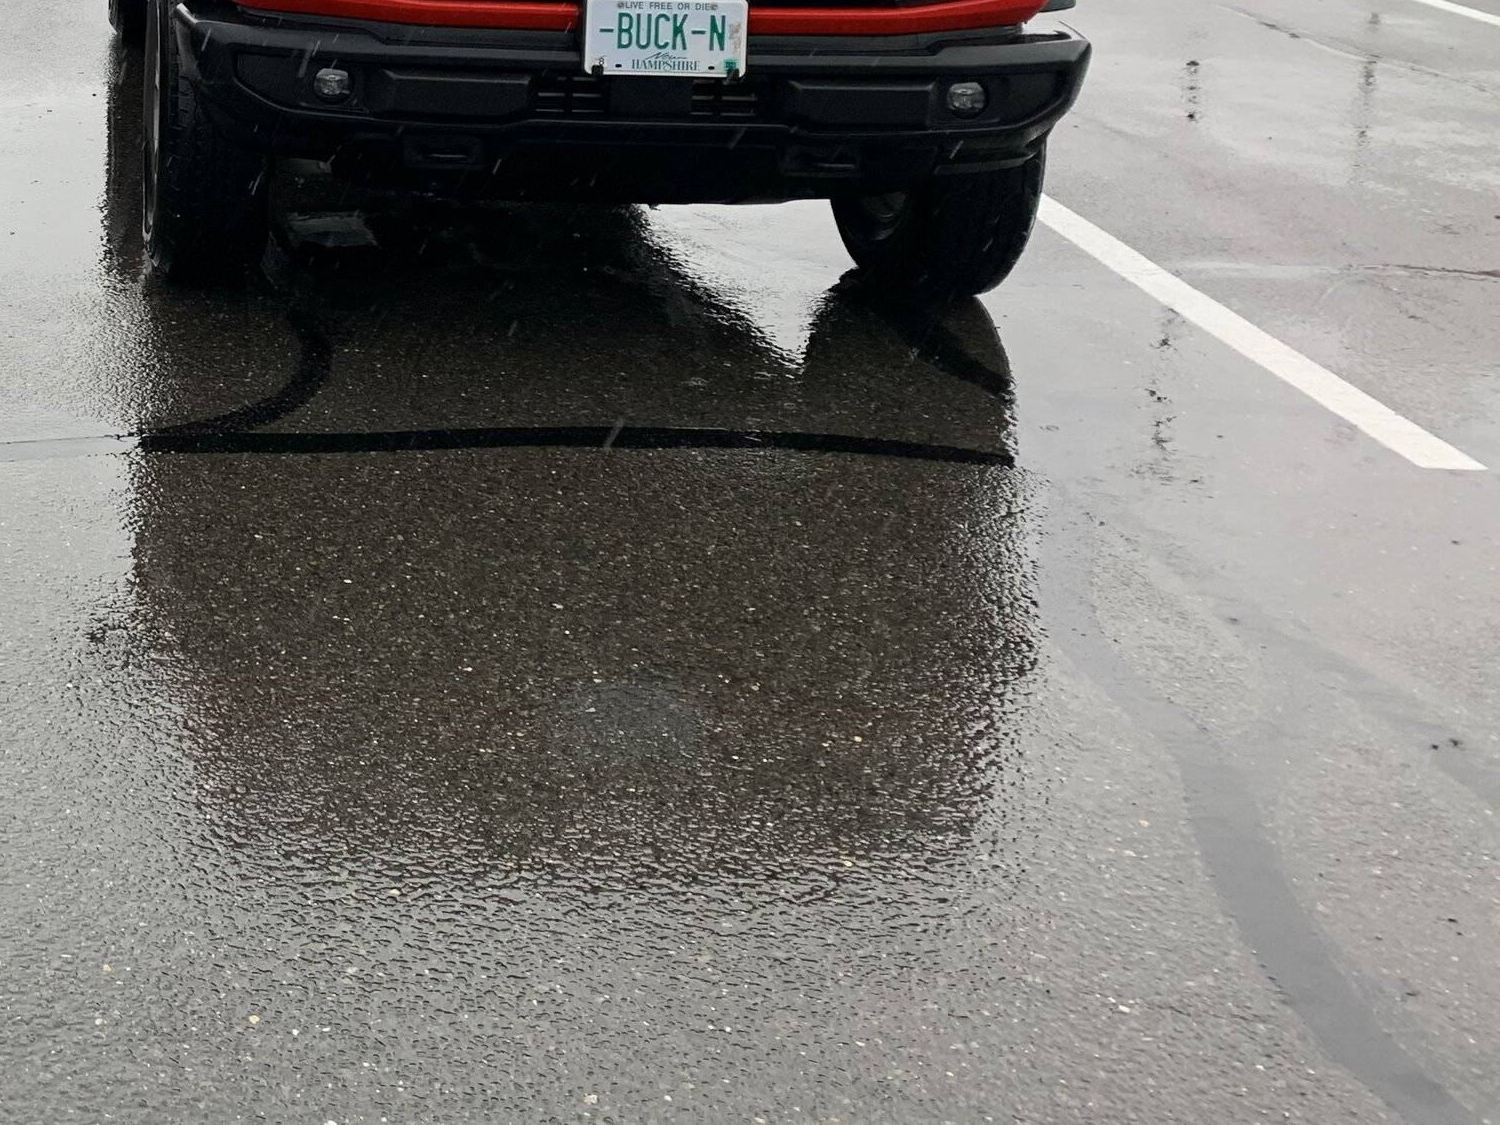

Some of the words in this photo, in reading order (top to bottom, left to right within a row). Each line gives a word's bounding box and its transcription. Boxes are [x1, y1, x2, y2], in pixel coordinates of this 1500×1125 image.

[625, 1, 644, 10] LIVE
[649, 1, 673, 10] FREE
[677, 2, 690, 11] OR
[695, 2, 710, 11] DIE
[631, 59, 701, 72] HAMPSHIRE
